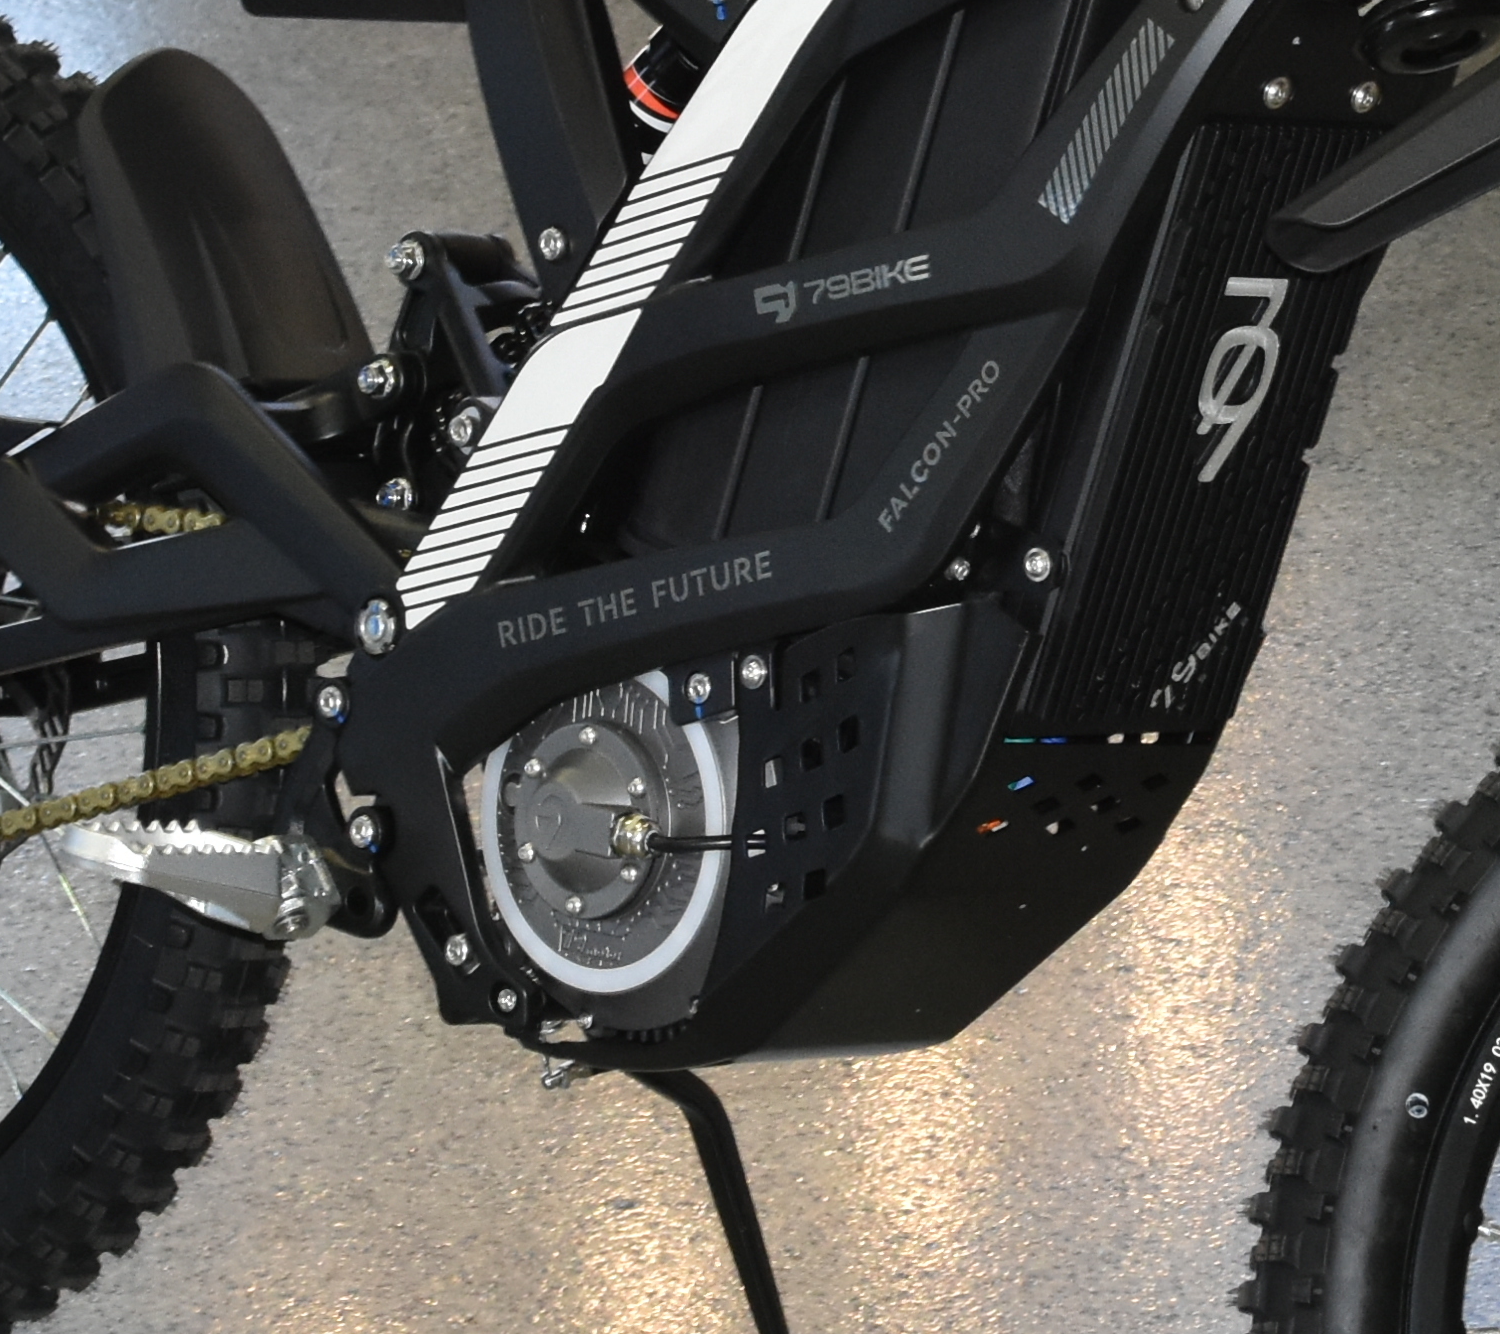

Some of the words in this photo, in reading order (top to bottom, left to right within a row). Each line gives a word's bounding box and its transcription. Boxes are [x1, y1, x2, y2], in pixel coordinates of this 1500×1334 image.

[803, 254, 931, 305] 79BIKE
[878, 360, 1000, 533] FALCON-PRO
[497, 607, 567, 648] RIDE
[578, 588, 637, 627] THE
[651, 550, 773, 608] FUTURE
